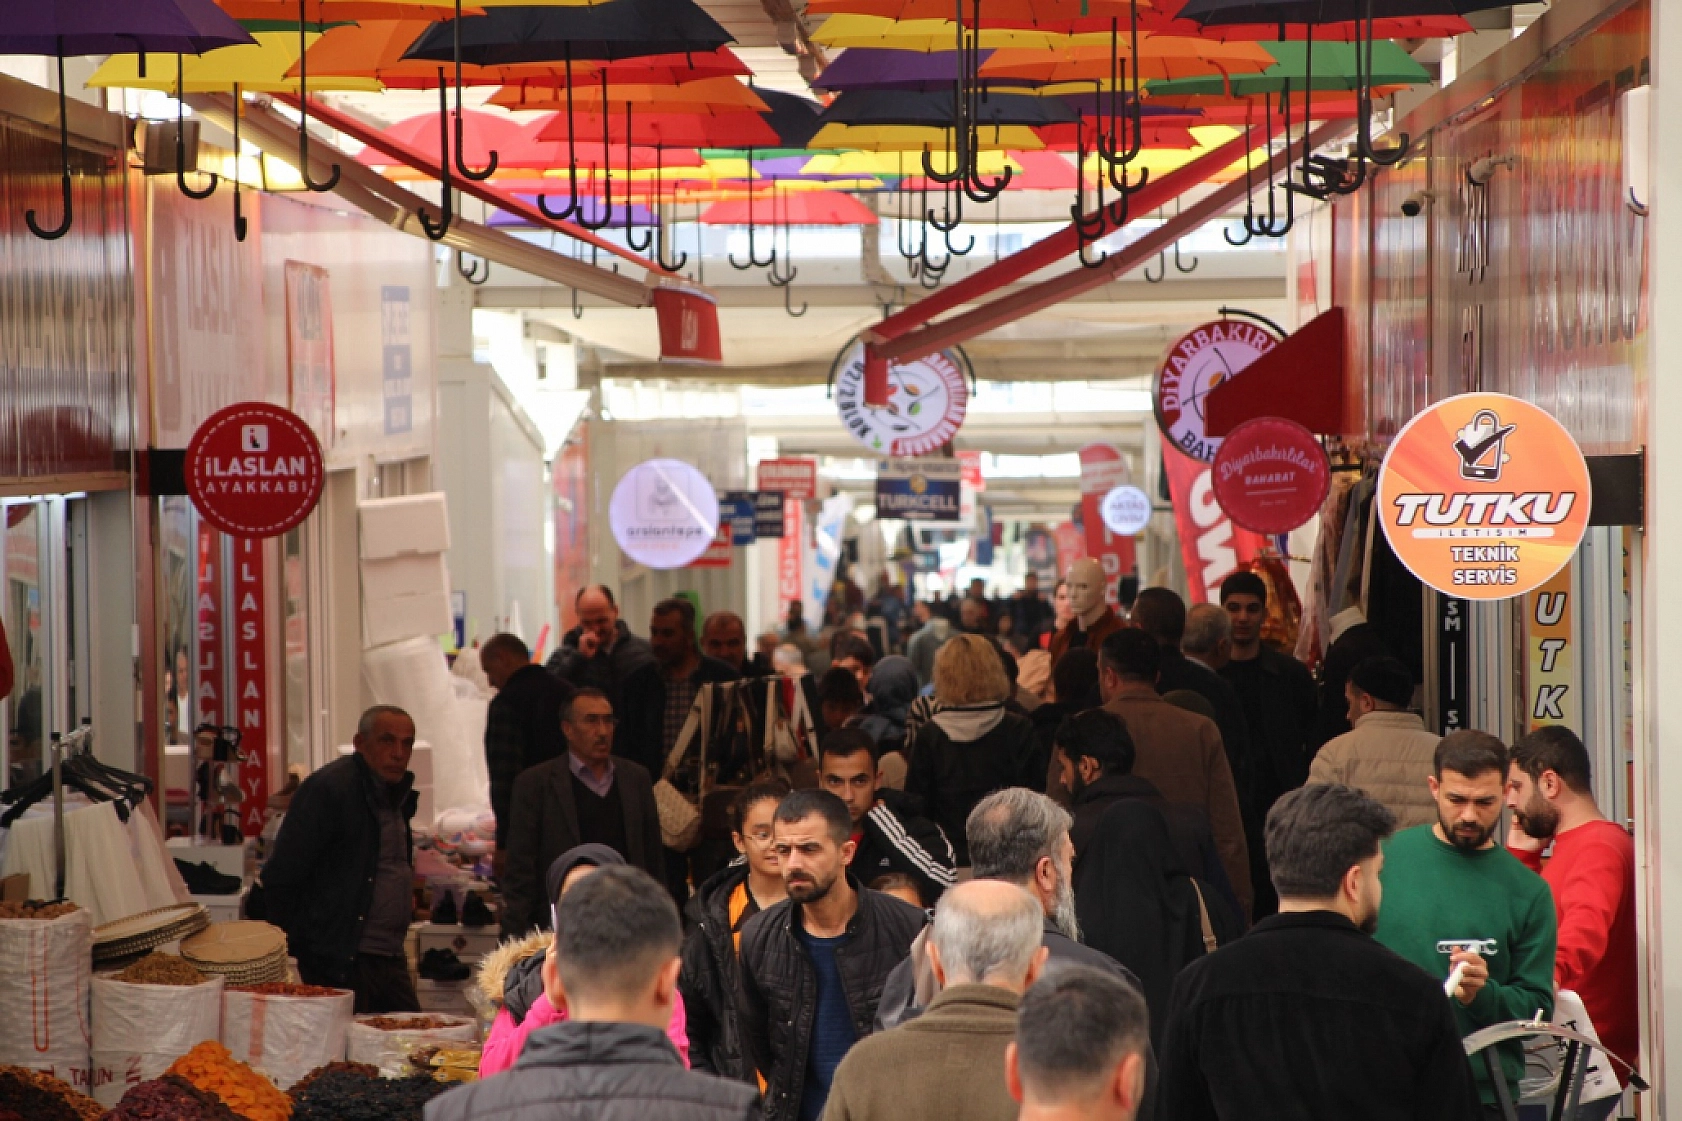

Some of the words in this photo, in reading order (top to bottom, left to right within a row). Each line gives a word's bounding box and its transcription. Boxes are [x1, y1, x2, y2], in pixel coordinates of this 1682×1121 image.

[205, 481, 308, 494] AYAKKABI
[1244, 471, 1296, 485] BAHARAT
[1393, 492, 1577, 527] TUTKU
[1450, 541, 1520, 562] TEKNİK
[1452, 564, 1517, 585] SERVİS
